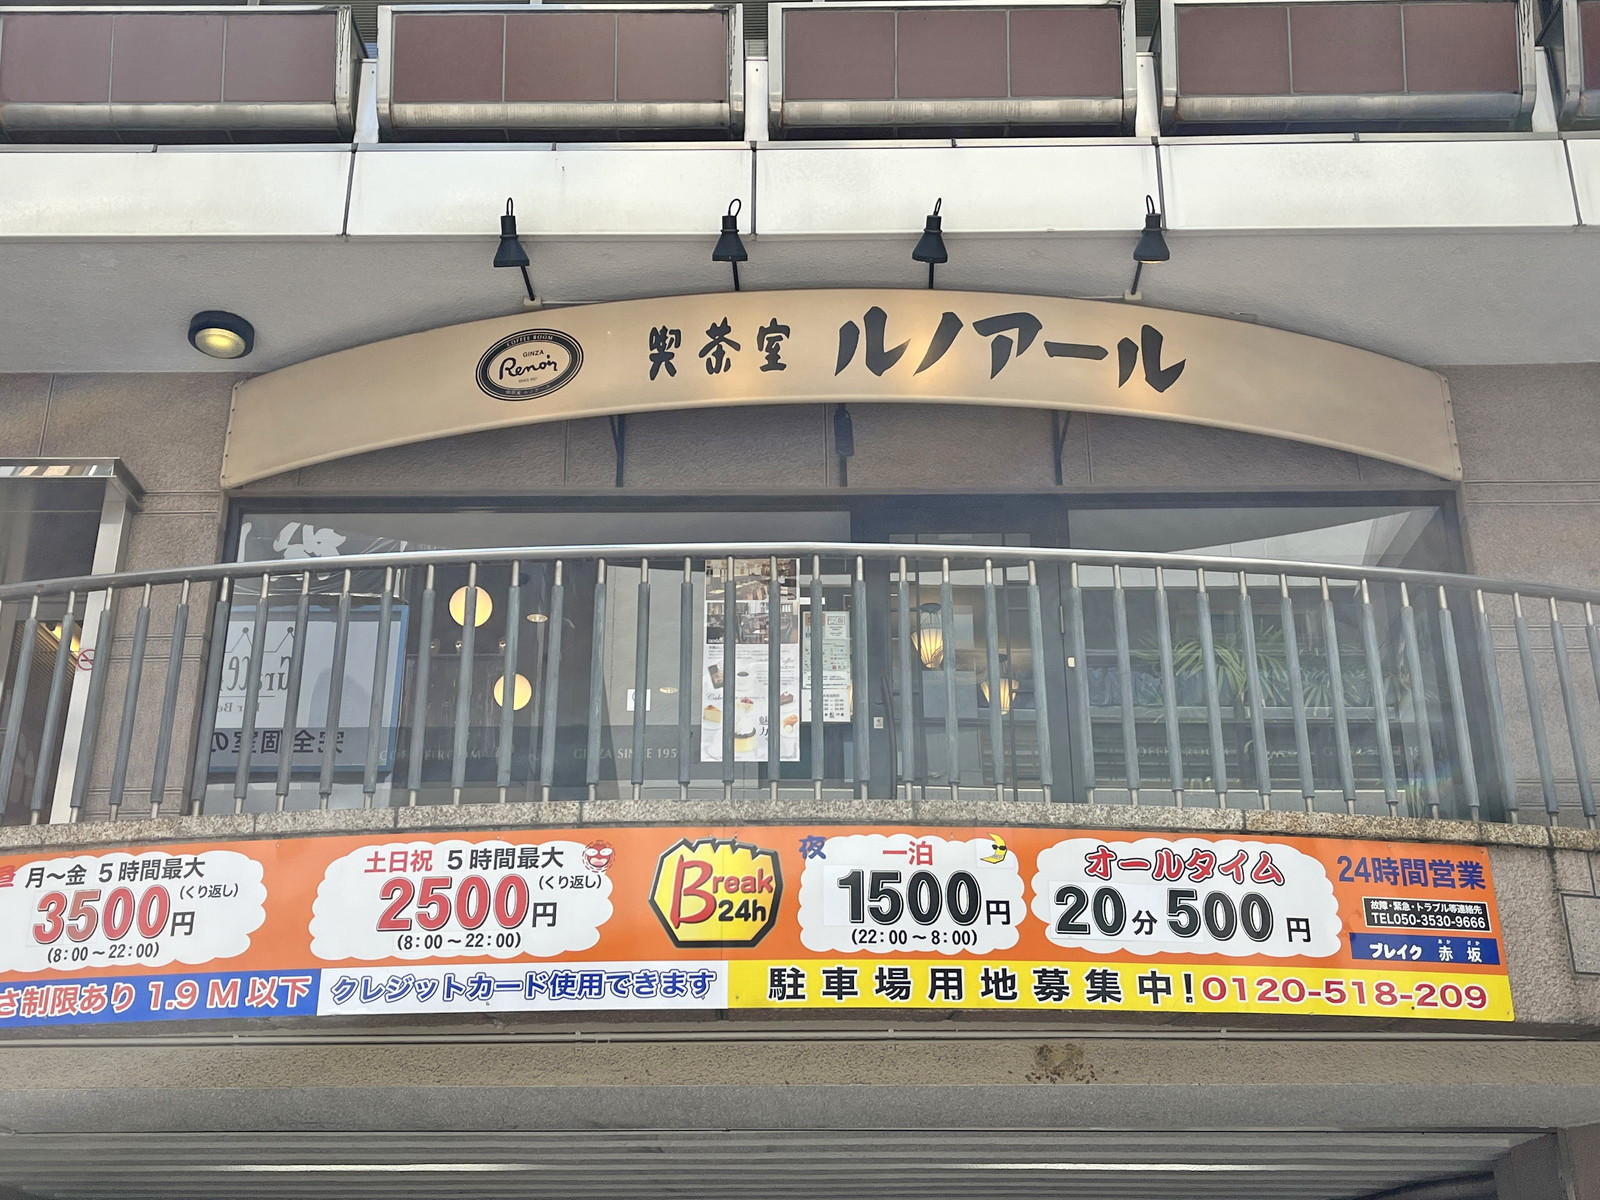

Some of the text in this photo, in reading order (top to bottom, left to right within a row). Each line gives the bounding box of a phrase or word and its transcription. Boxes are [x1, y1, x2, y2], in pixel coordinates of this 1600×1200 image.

[522, 349, 544, 358] GINZA
[648, 305, 1187, 394] 喫茶室 ルノアール
[499, 354, 558, 380] Renoir
[617, 747, 653, 760] SINE
[364, 847, 565, 874] 土日祝 5時間最大
[798, 835, 827, 861] 夜
[882, 841, 934, 867] 一泊
[98, 857, 206, 883] 5時間最大
[1084, 844, 1286, 886] オールタイム
[1336, 855, 1487, 890] 24時間営業
[179, 882, 240, 900] (くり返し)
[539, 873, 602, 891] (くり返し)
[674, 854, 774, 930] Break
[717, 901, 768, 923] 24h
[1370, 900, 1483, 915] 故障・緊急・トラブル等連絡先
[1371, 912, 1486, 929] TEL050-3530-9666
[1369, 942, 1483, 963] ブレイク 赤坂
[331, 968, 717, 1005] クレジットカード使用できます
[768, 966, 1489, 1010] 駐車場用地募集中! 0120-518-209
